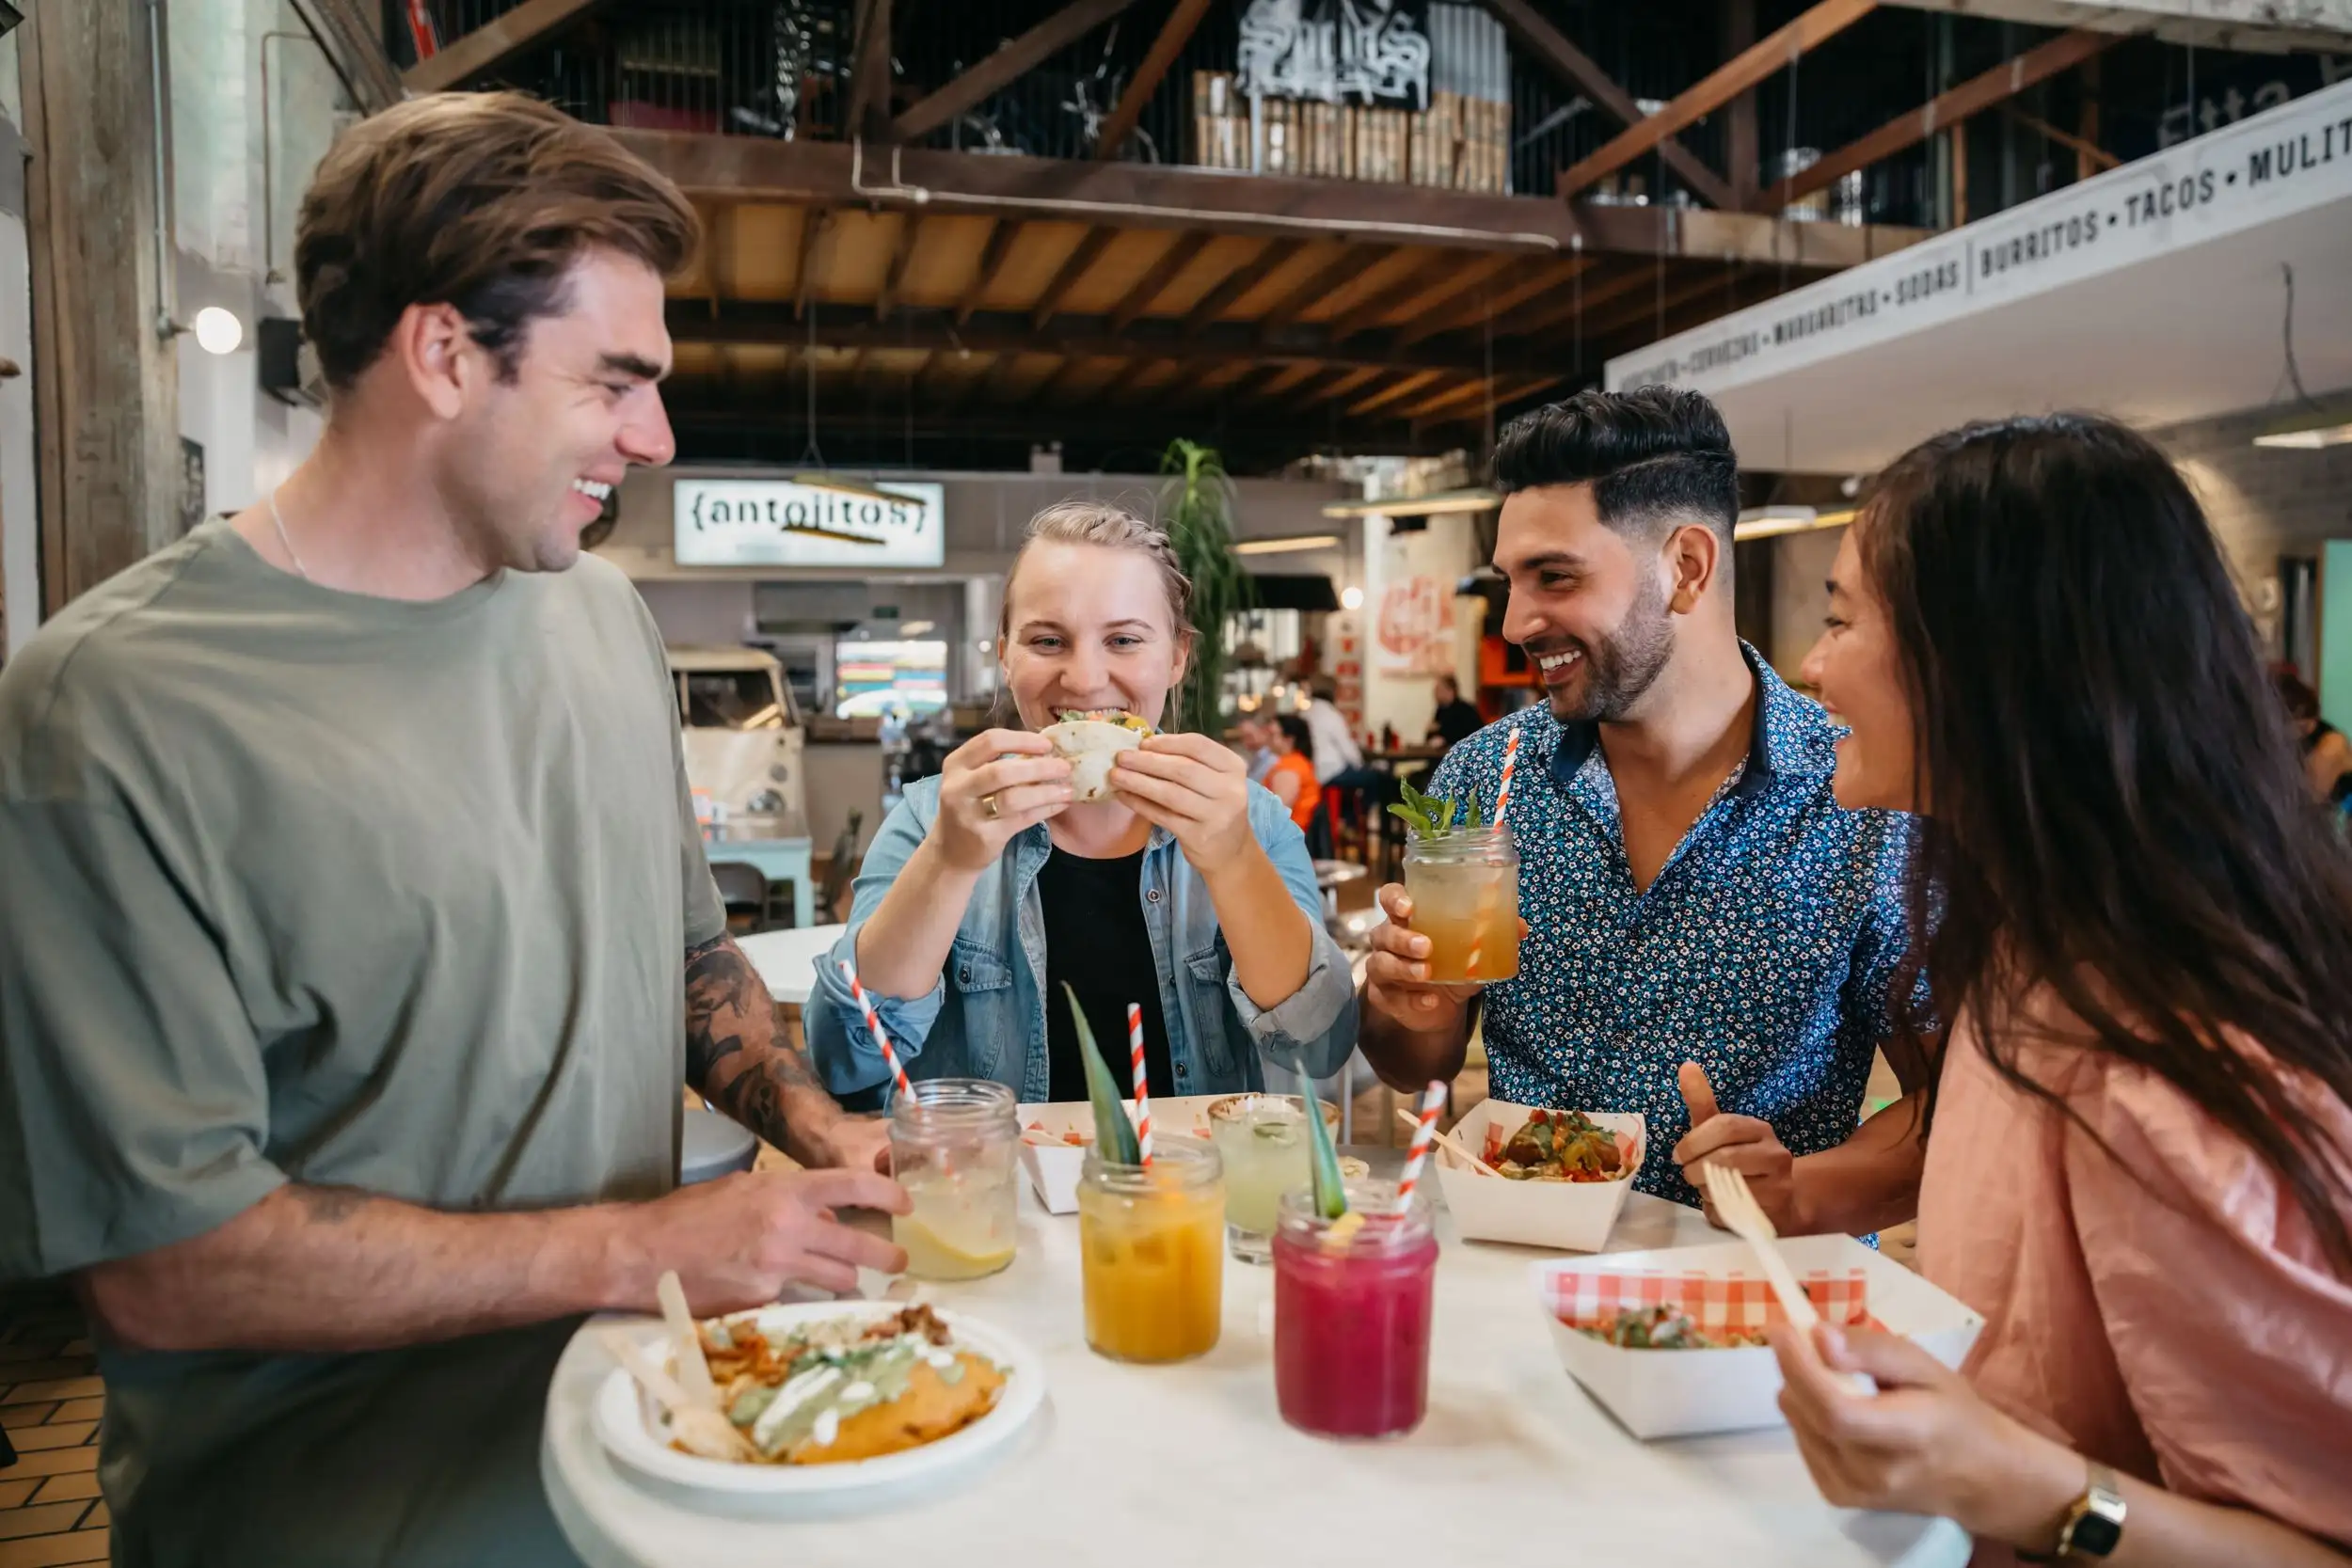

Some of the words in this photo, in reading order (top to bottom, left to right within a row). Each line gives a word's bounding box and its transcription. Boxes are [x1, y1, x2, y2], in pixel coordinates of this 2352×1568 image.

[1896, 261, 1958, 307] SODAS
[1980, 212, 2098, 277] BURRITOS
[2124, 169, 2215, 227] TACOS
[2249, 118, 2352, 186] MULIT
